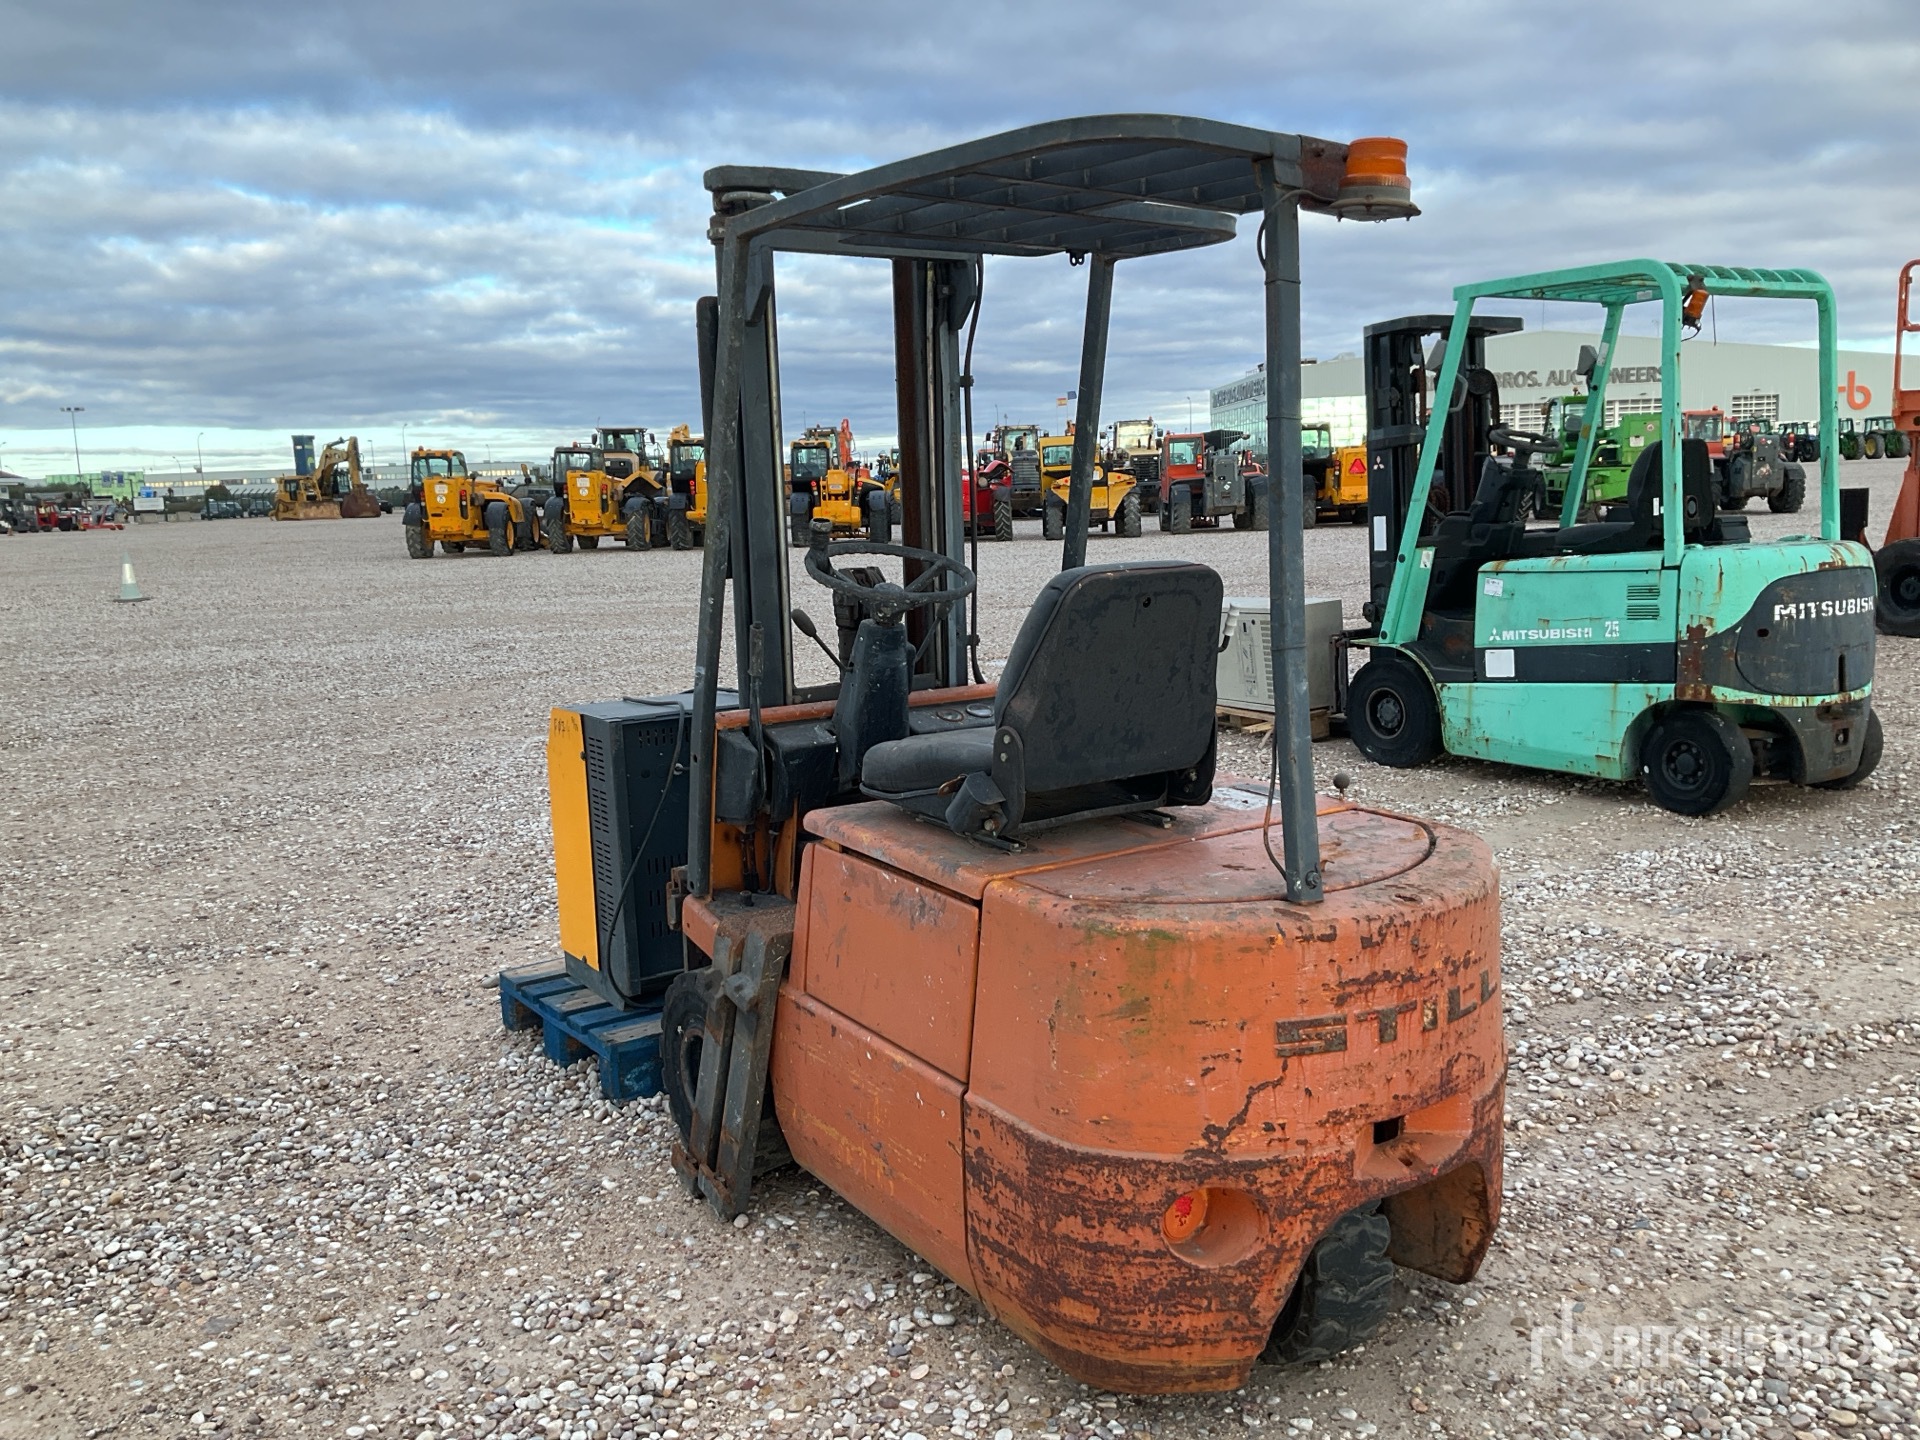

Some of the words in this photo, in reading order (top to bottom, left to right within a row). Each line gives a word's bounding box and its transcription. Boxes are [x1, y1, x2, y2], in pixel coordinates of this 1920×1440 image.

[1546, 366, 1662, 387] AUCNEERS
[1838, 370, 1872, 410] b
[1502, 627, 1592, 641] MITSUBISHI
[1274, 969, 1498, 1058] STILL
